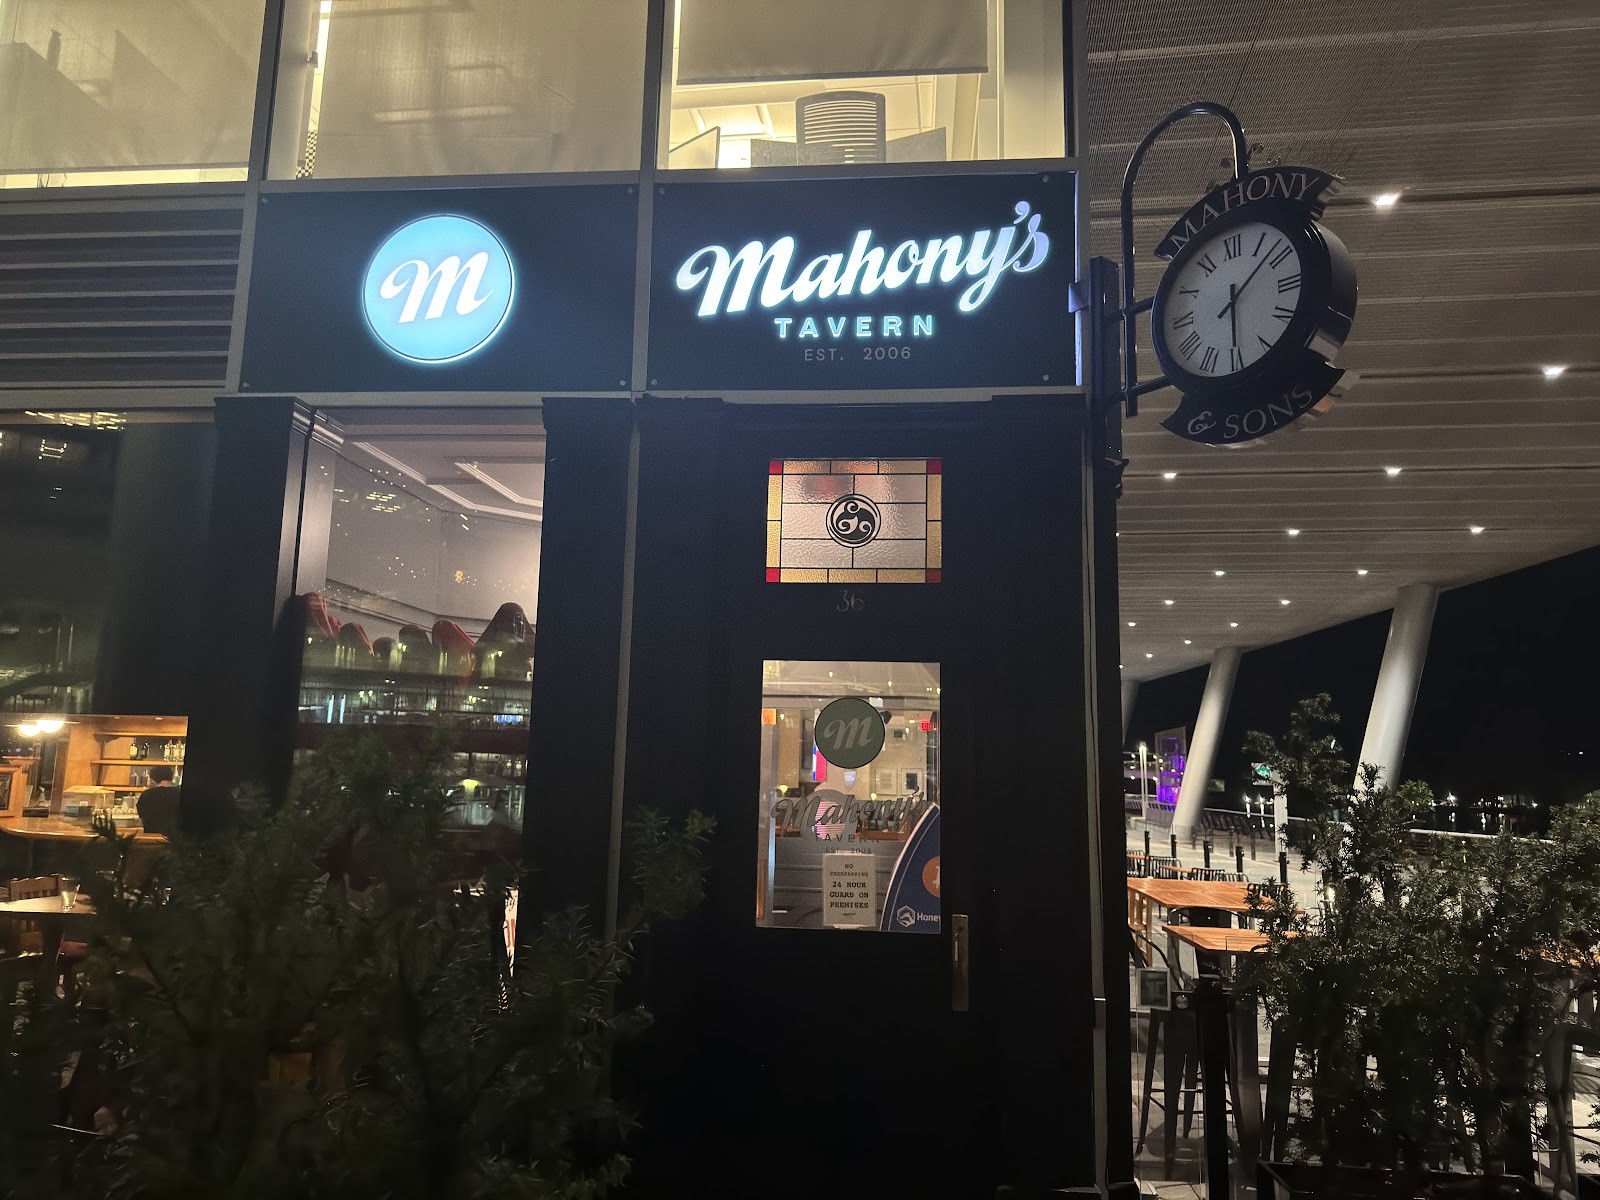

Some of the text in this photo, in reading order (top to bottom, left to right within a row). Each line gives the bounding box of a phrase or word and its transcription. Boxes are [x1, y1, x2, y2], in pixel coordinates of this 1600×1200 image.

[1170, 173, 1319, 252] MAHONY
[675, 201, 1050, 317] Mahony's
[774, 315, 933, 338] TAVERN
[804, 346, 911, 361] EST. 2006
[1187, 383, 1313, 440] & SONS
